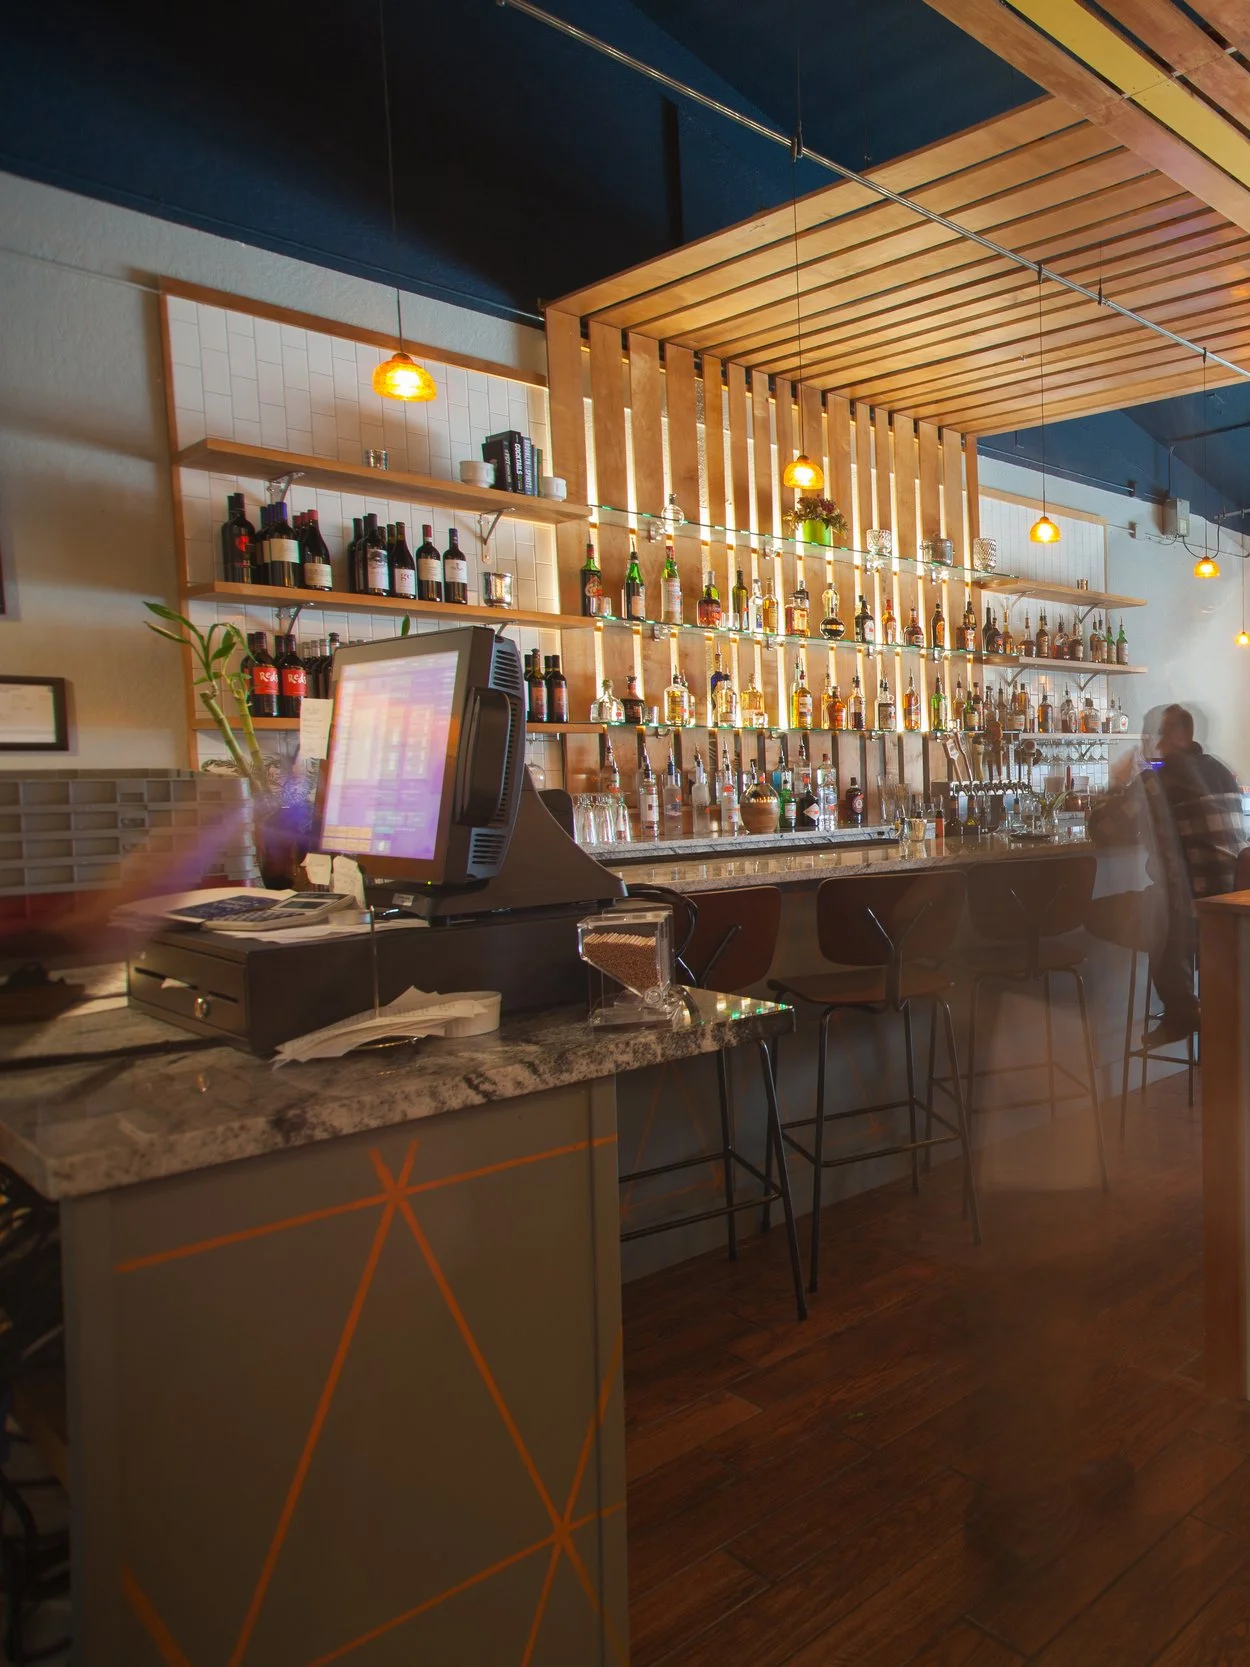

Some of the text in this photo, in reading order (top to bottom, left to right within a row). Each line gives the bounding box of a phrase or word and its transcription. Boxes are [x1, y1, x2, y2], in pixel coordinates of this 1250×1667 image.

[514, 443, 523, 475] COCKTAILS
[523, 439, 533, 489] BROOKLYN SPIRITS
